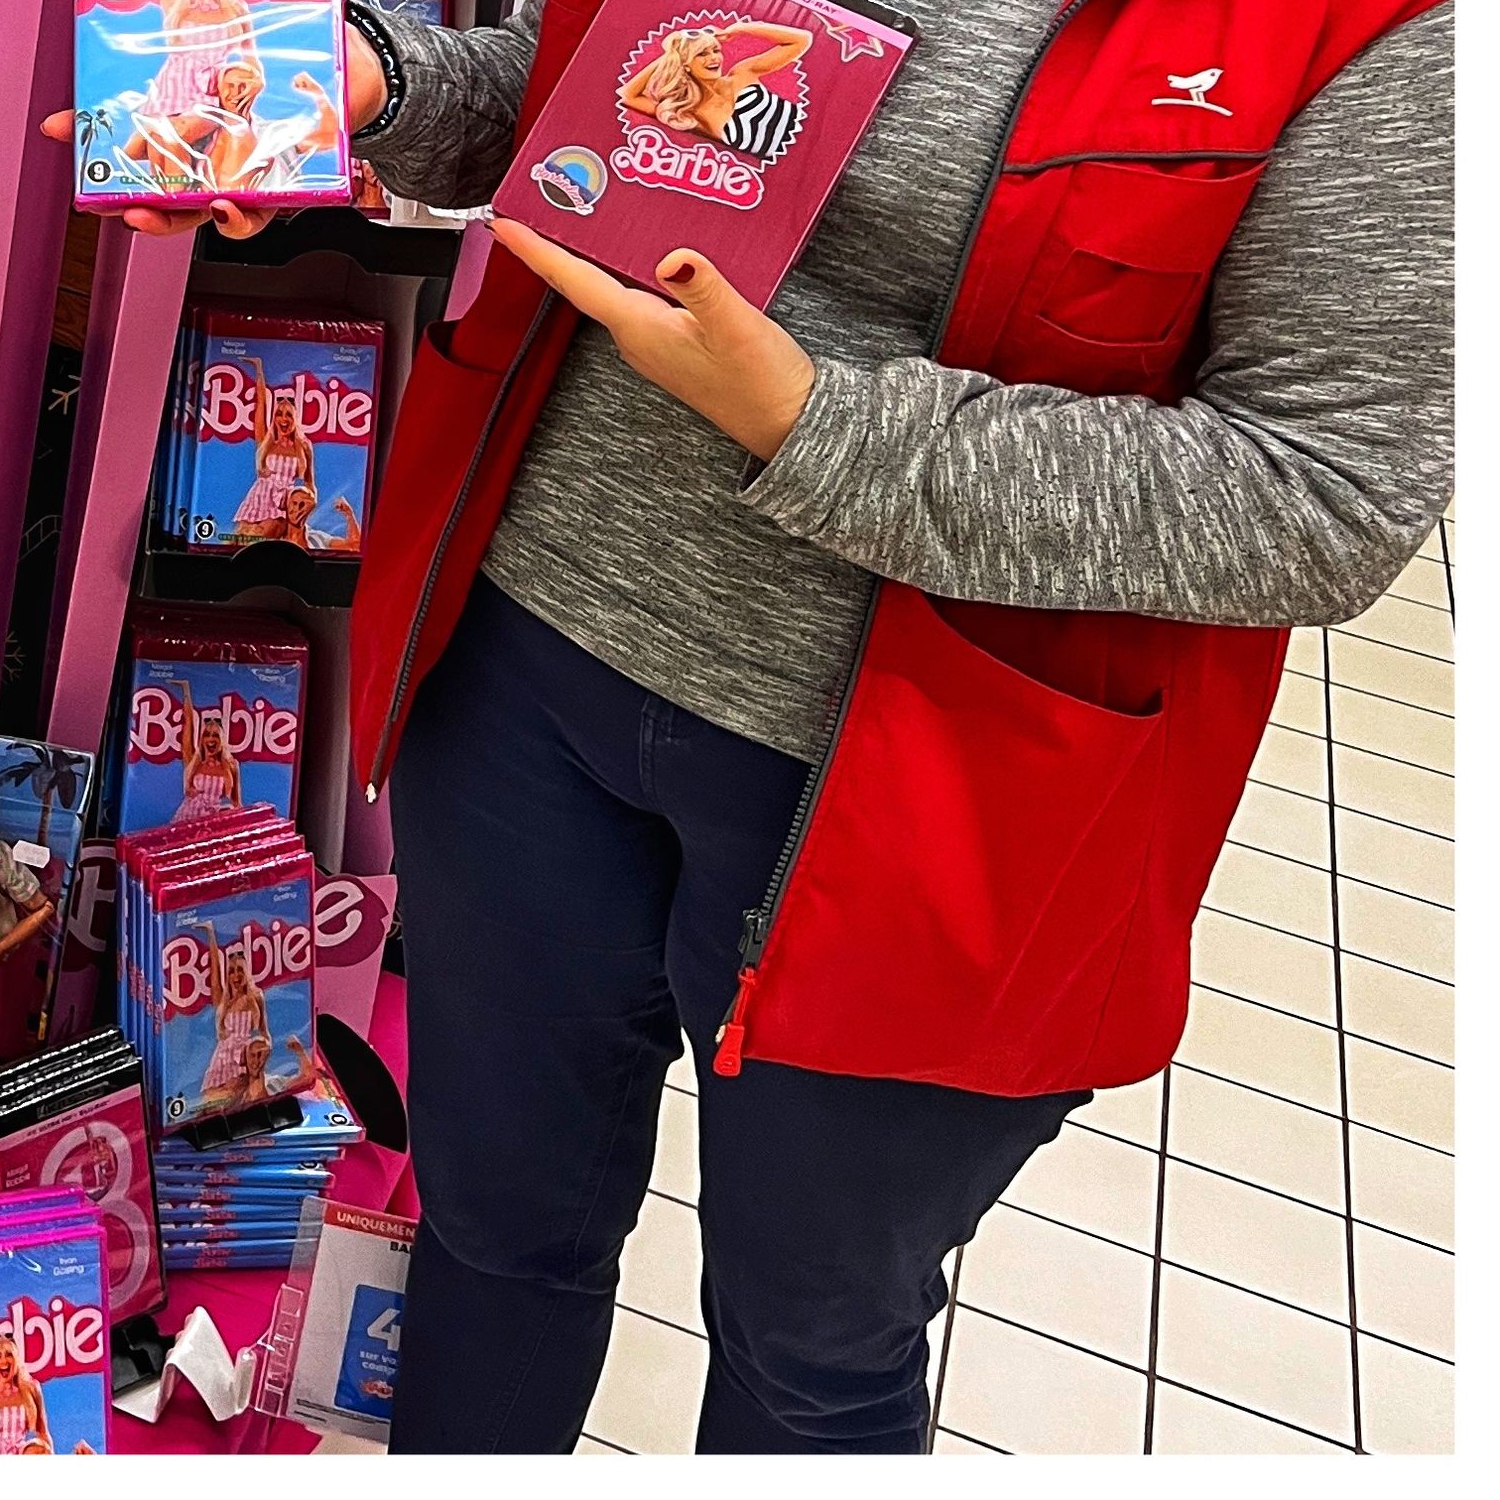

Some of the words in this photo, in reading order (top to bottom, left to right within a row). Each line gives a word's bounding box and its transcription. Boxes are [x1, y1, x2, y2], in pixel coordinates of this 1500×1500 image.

[616, 132, 750, 196] Barbie
[198, 365, 373, 437] Barbie
[130, 687, 297, 755] Barbie
[163, 920, 312, 1010] Barbie
